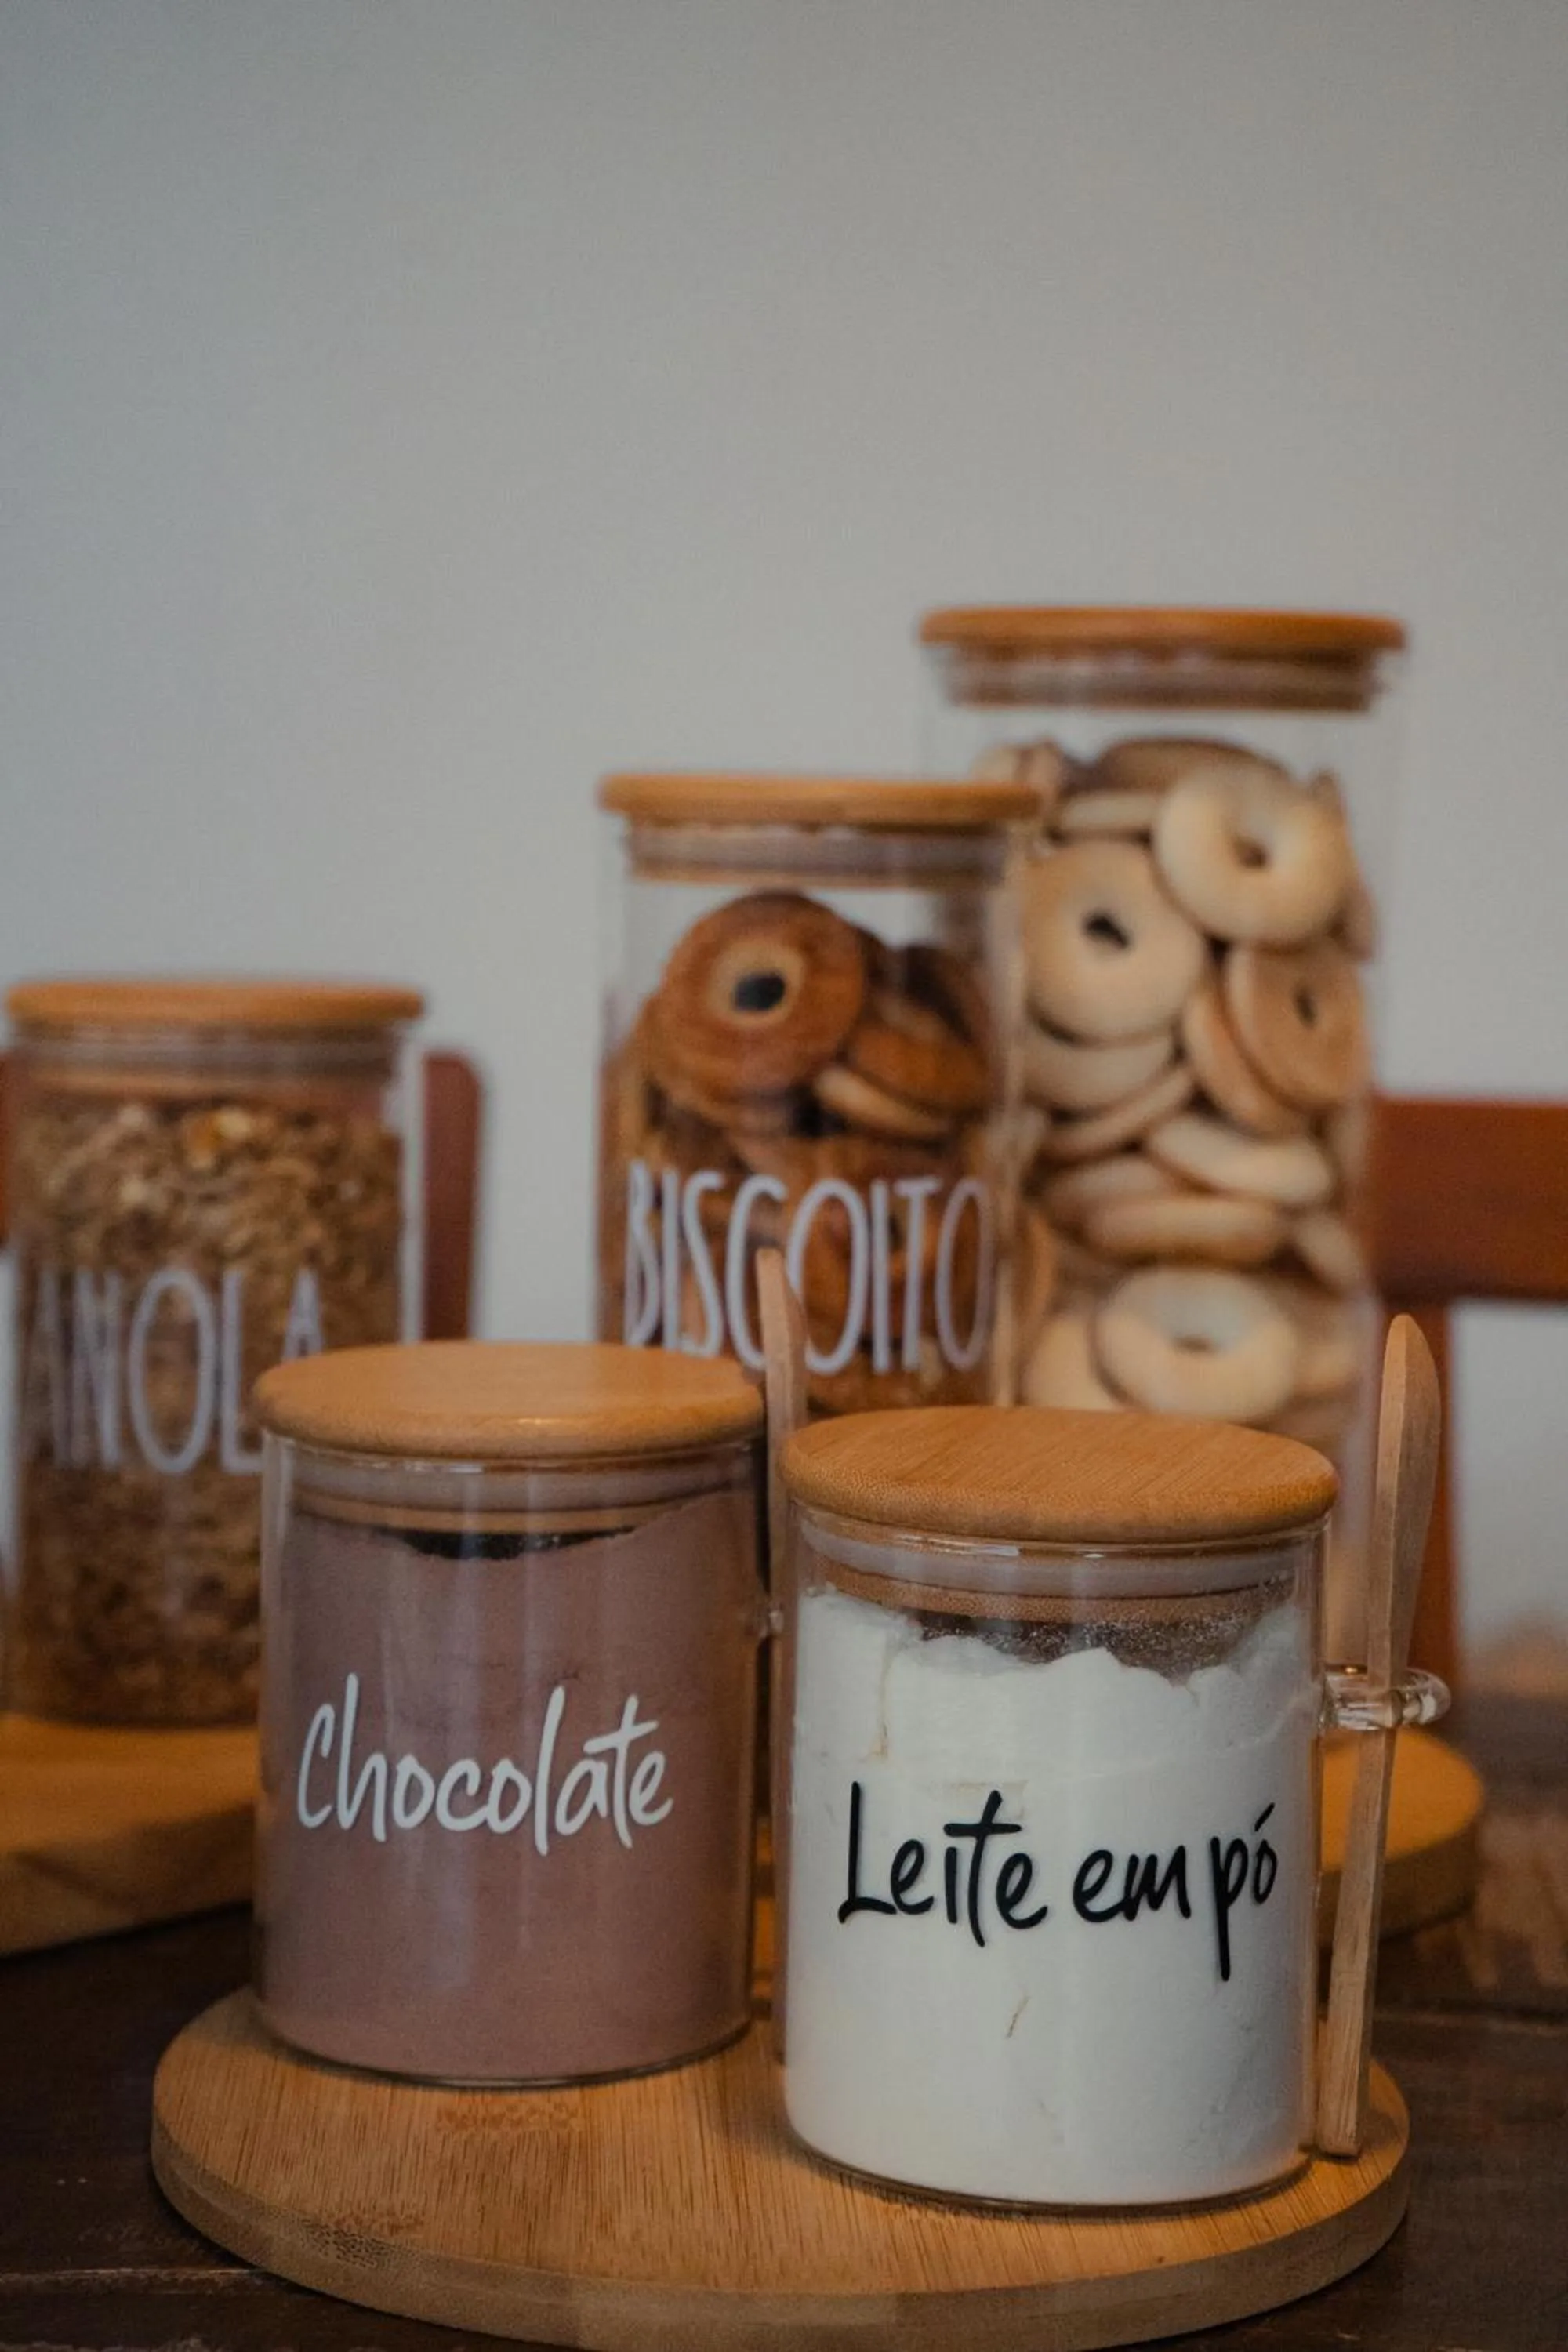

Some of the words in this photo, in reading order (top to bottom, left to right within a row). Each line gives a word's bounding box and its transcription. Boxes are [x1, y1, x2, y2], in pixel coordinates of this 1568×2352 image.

[623, 1159, 996, 1374] BISCOITO
[297, 1671, 673, 1856] Chocolate
[837, 1780, 1048, 1947] Leite
[1072, 1844, 1191, 1924] em
[1210, 1802, 1278, 1982] pó
